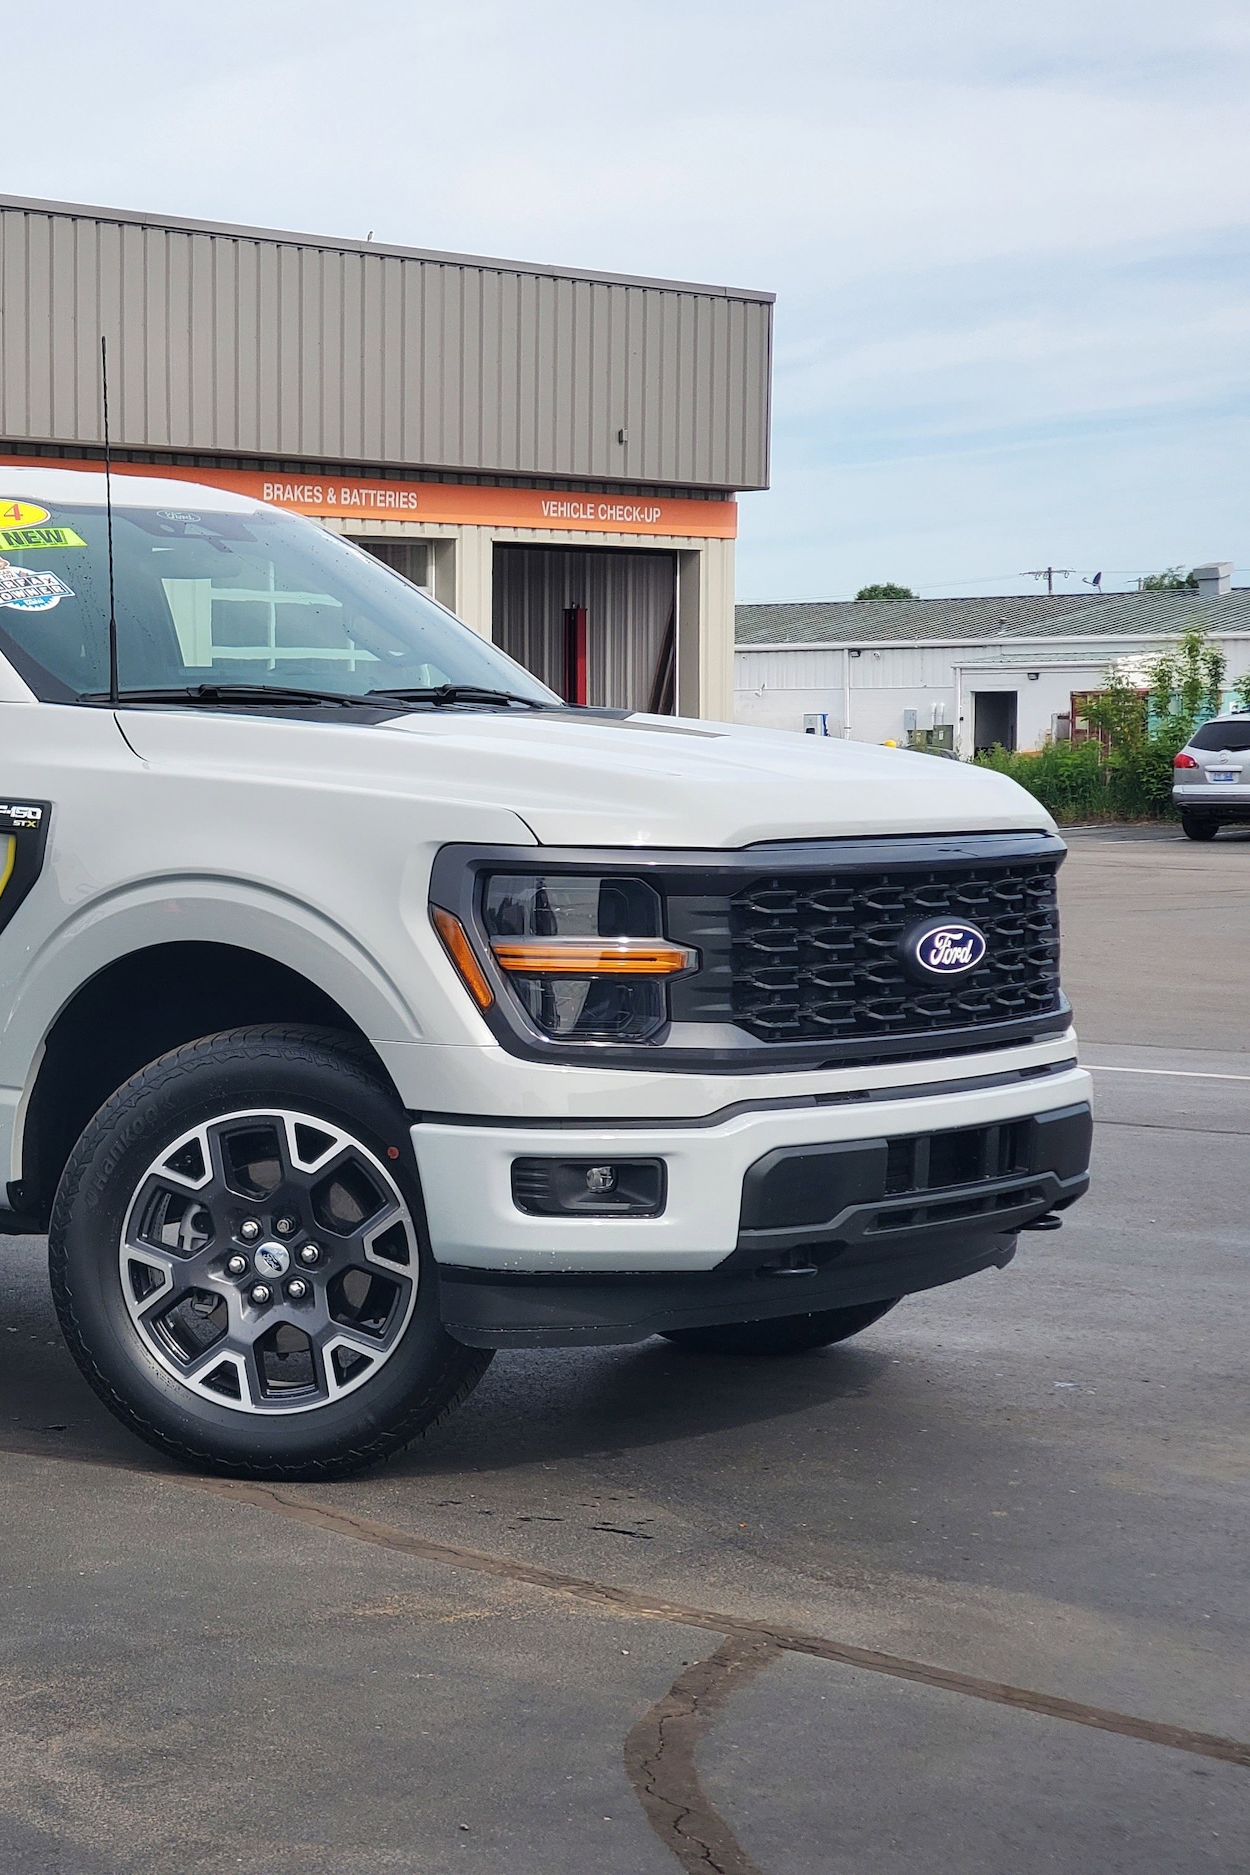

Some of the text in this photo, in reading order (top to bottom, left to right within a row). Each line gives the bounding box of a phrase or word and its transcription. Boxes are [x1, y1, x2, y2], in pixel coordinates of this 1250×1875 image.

[263, 482, 418, 509] BRAKES & BATTERIES
[541, 500, 661, 523] VEHICLE CHECK-UP
[0, 528, 68, 548] NEW
[12, 819, 37, 828] STX
[930, 932, 973, 965] Ford
